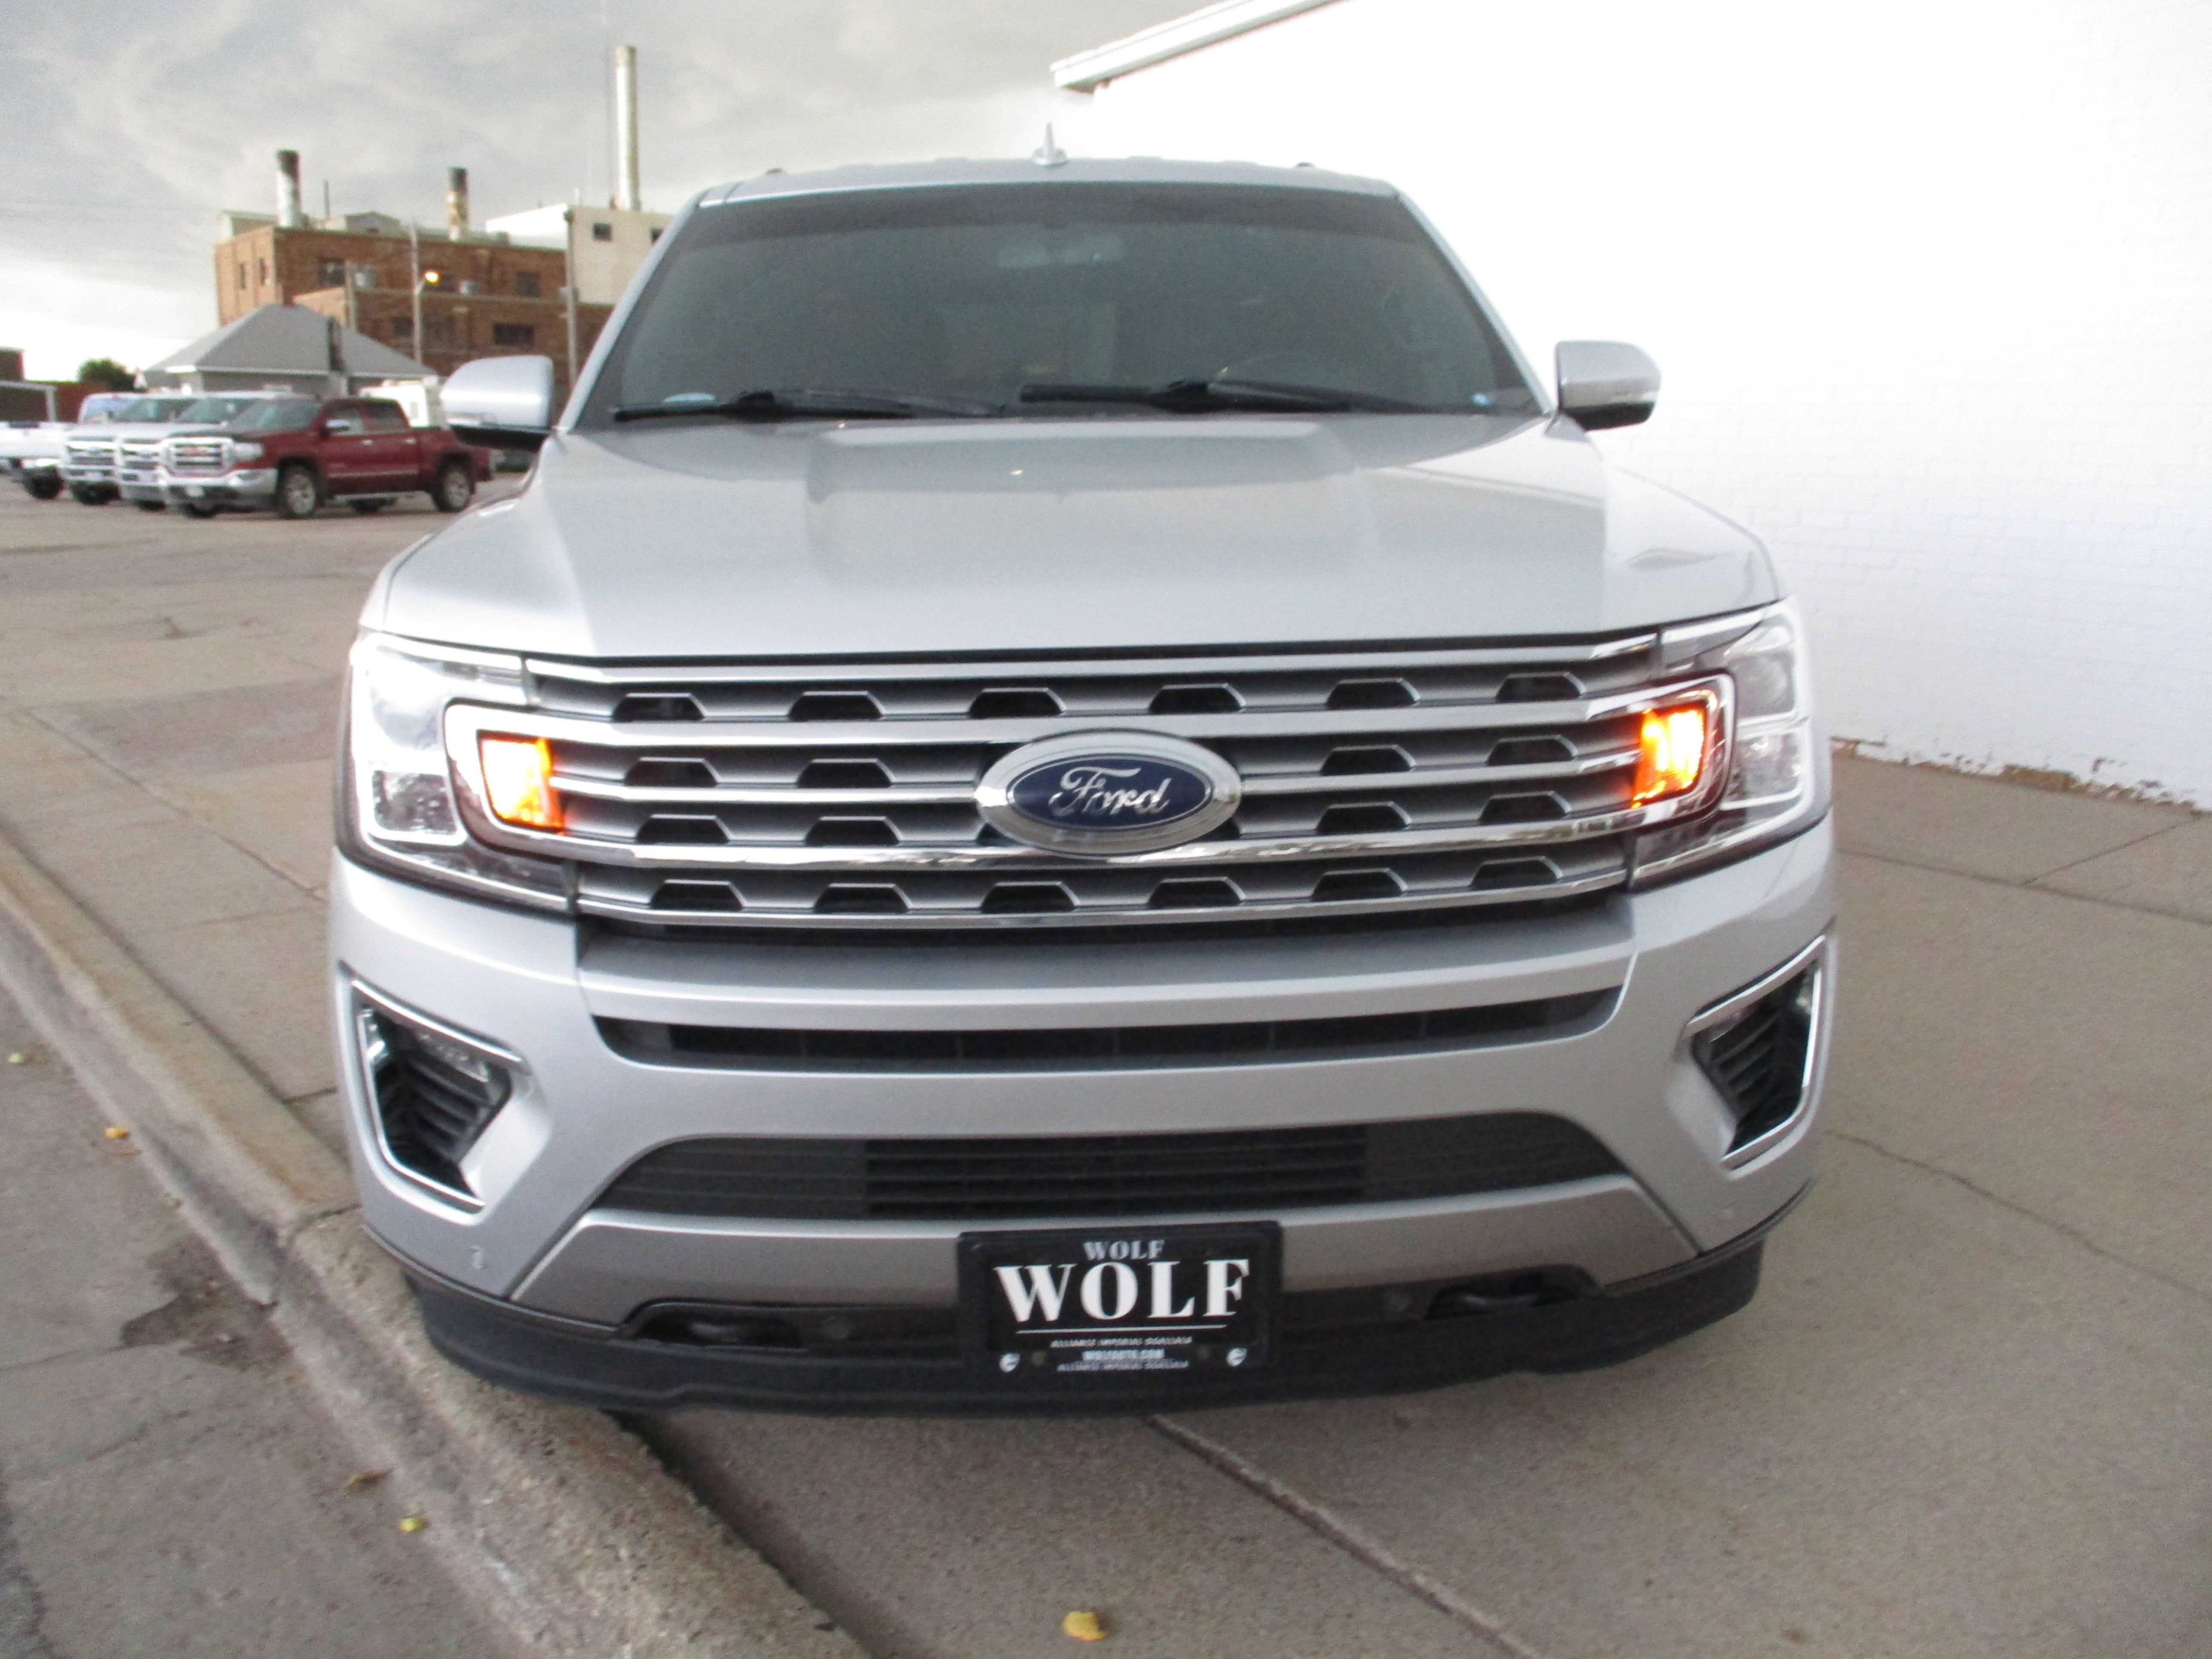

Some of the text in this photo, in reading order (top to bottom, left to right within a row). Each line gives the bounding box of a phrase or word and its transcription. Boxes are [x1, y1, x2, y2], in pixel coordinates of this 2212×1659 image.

[1048, 766, 1171, 816] Ford
[1082, 1239, 1165, 1261] WOLF
[994, 1258, 1250, 1323] WOLF
